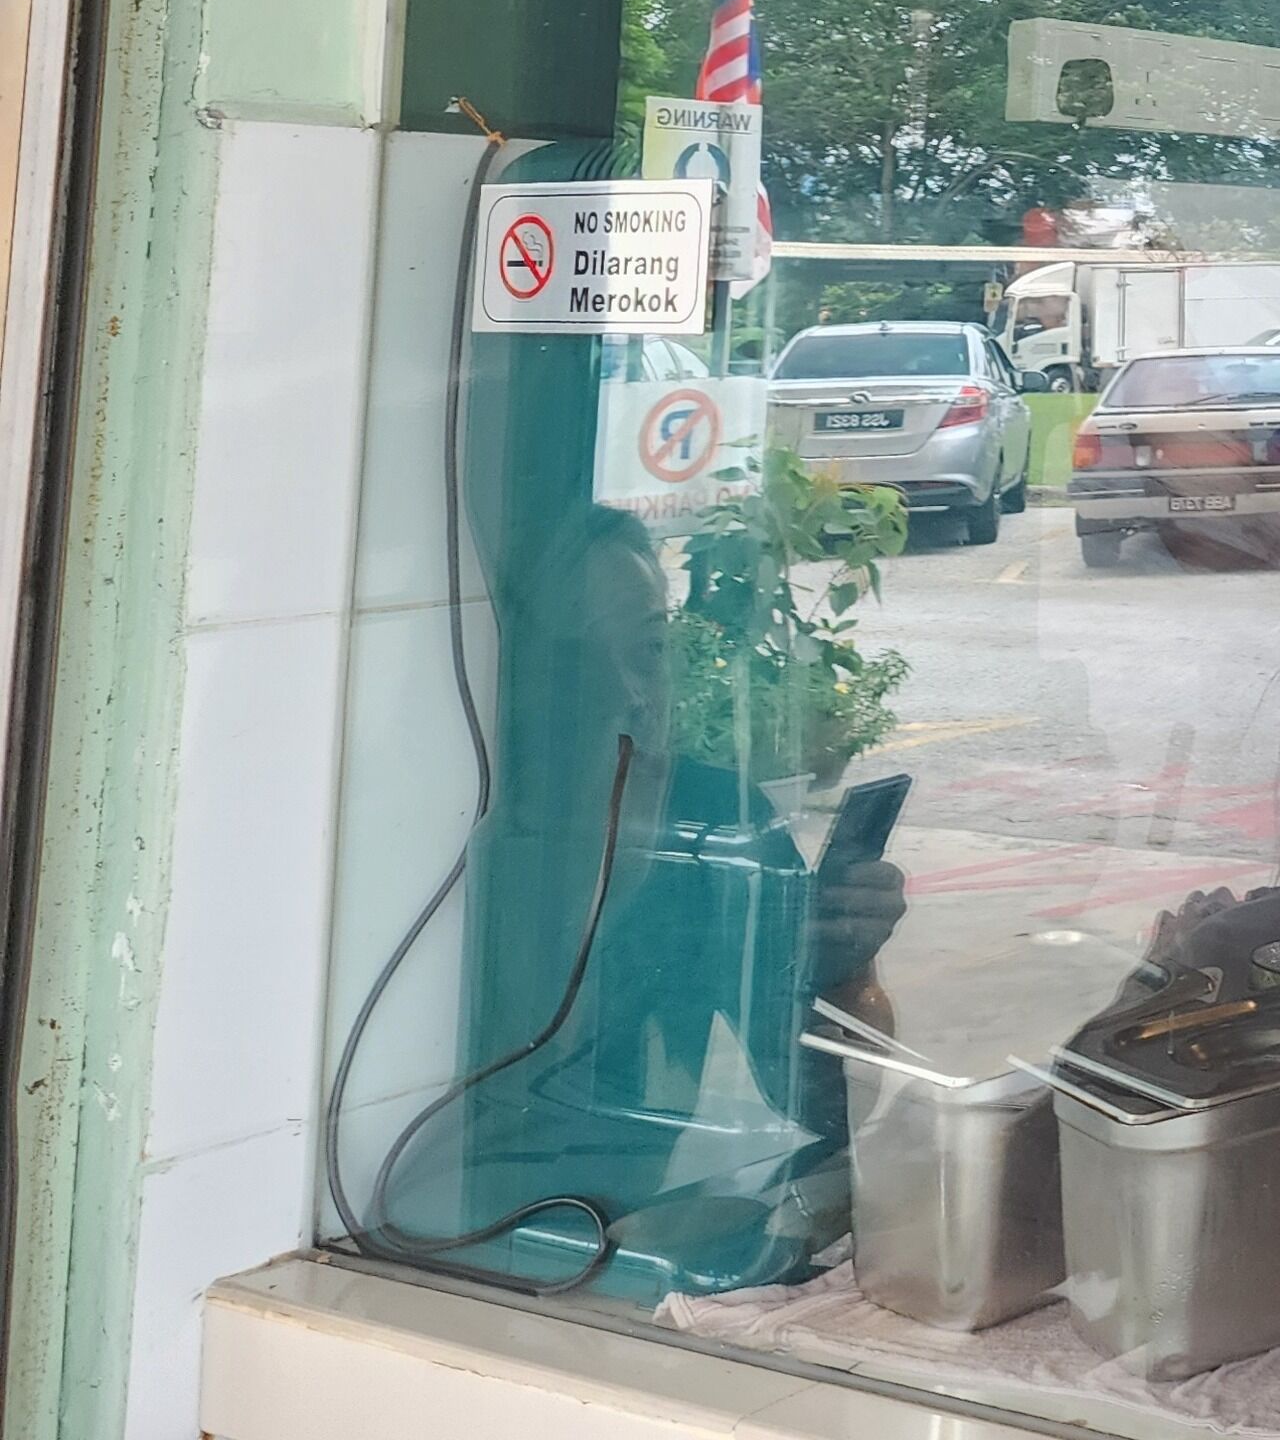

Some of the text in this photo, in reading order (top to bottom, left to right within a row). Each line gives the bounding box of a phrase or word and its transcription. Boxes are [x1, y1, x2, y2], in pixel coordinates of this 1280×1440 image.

[573, 209, 687, 235] NO SMOKING
[573, 250, 680, 282] Dilarang
[569, 286, 679, 315] Merokok
